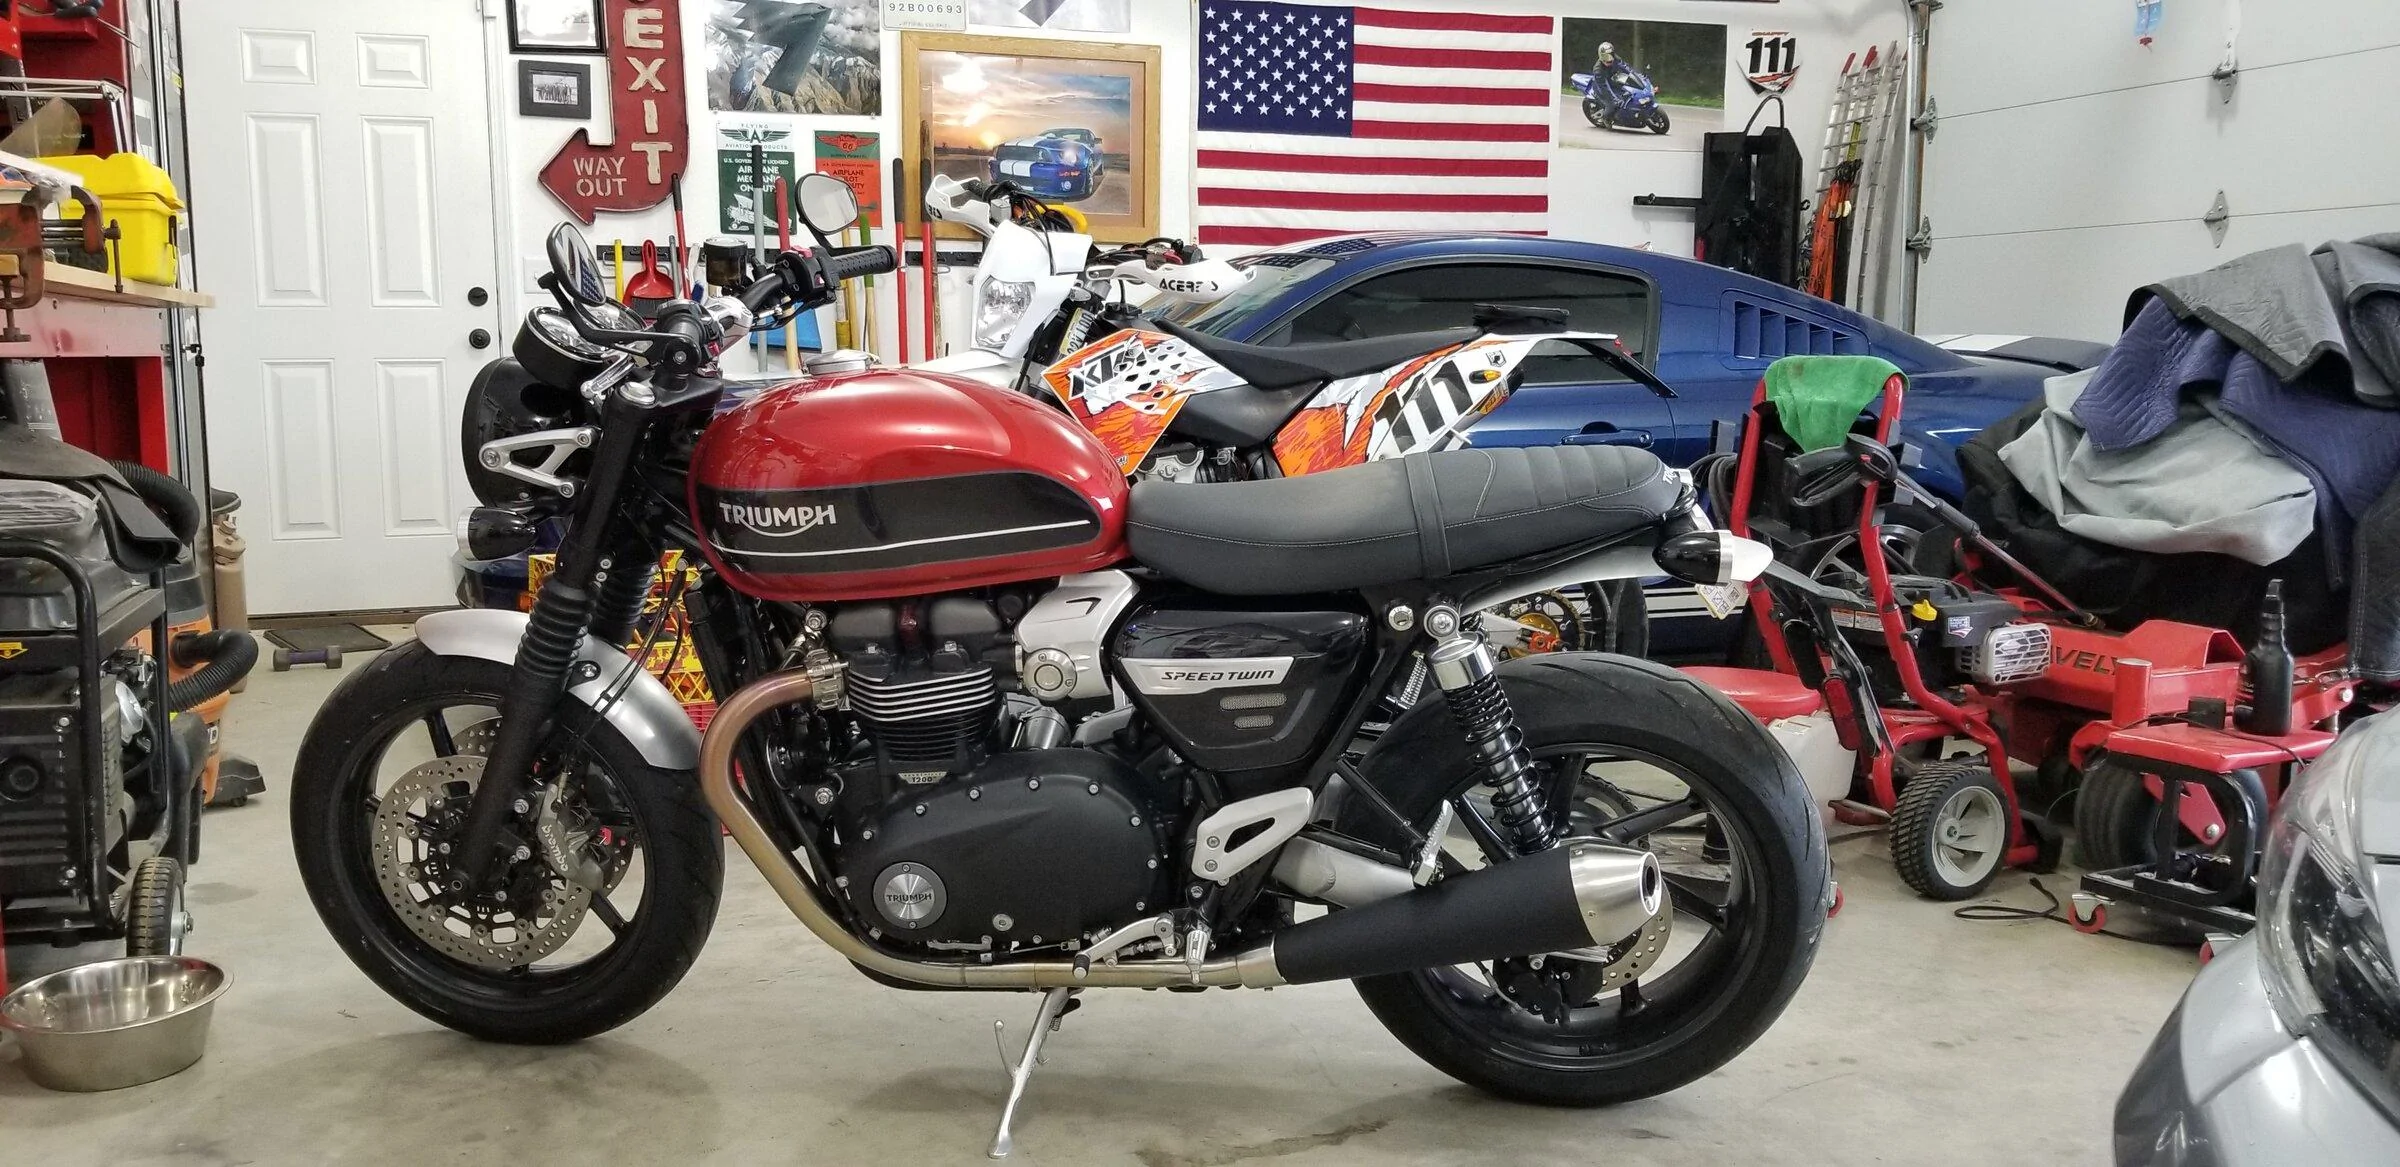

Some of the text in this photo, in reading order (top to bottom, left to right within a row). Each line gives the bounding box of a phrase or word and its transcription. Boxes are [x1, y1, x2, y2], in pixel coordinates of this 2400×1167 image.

[889, 2, 962, 14] 92B00693
[1745, 37, 1797, 74] 111
[623, 8, 674, 185] EXIT
[573, 157, 625, 176] WAY
[738, 165, 780, 174] AIRANE
[833, 169, 864, 177] AIRPLANE
[576, 178, 627, 196] OUT
[1373, 359, 1474, 454] 111
[719, 501, 837, 536] TRIUMPH
[1161, 669, 1275, 681] SPEED TWIN
[541, 823, 569, 872] brembo
[886, 892, 933, 904] TRIUMPH
